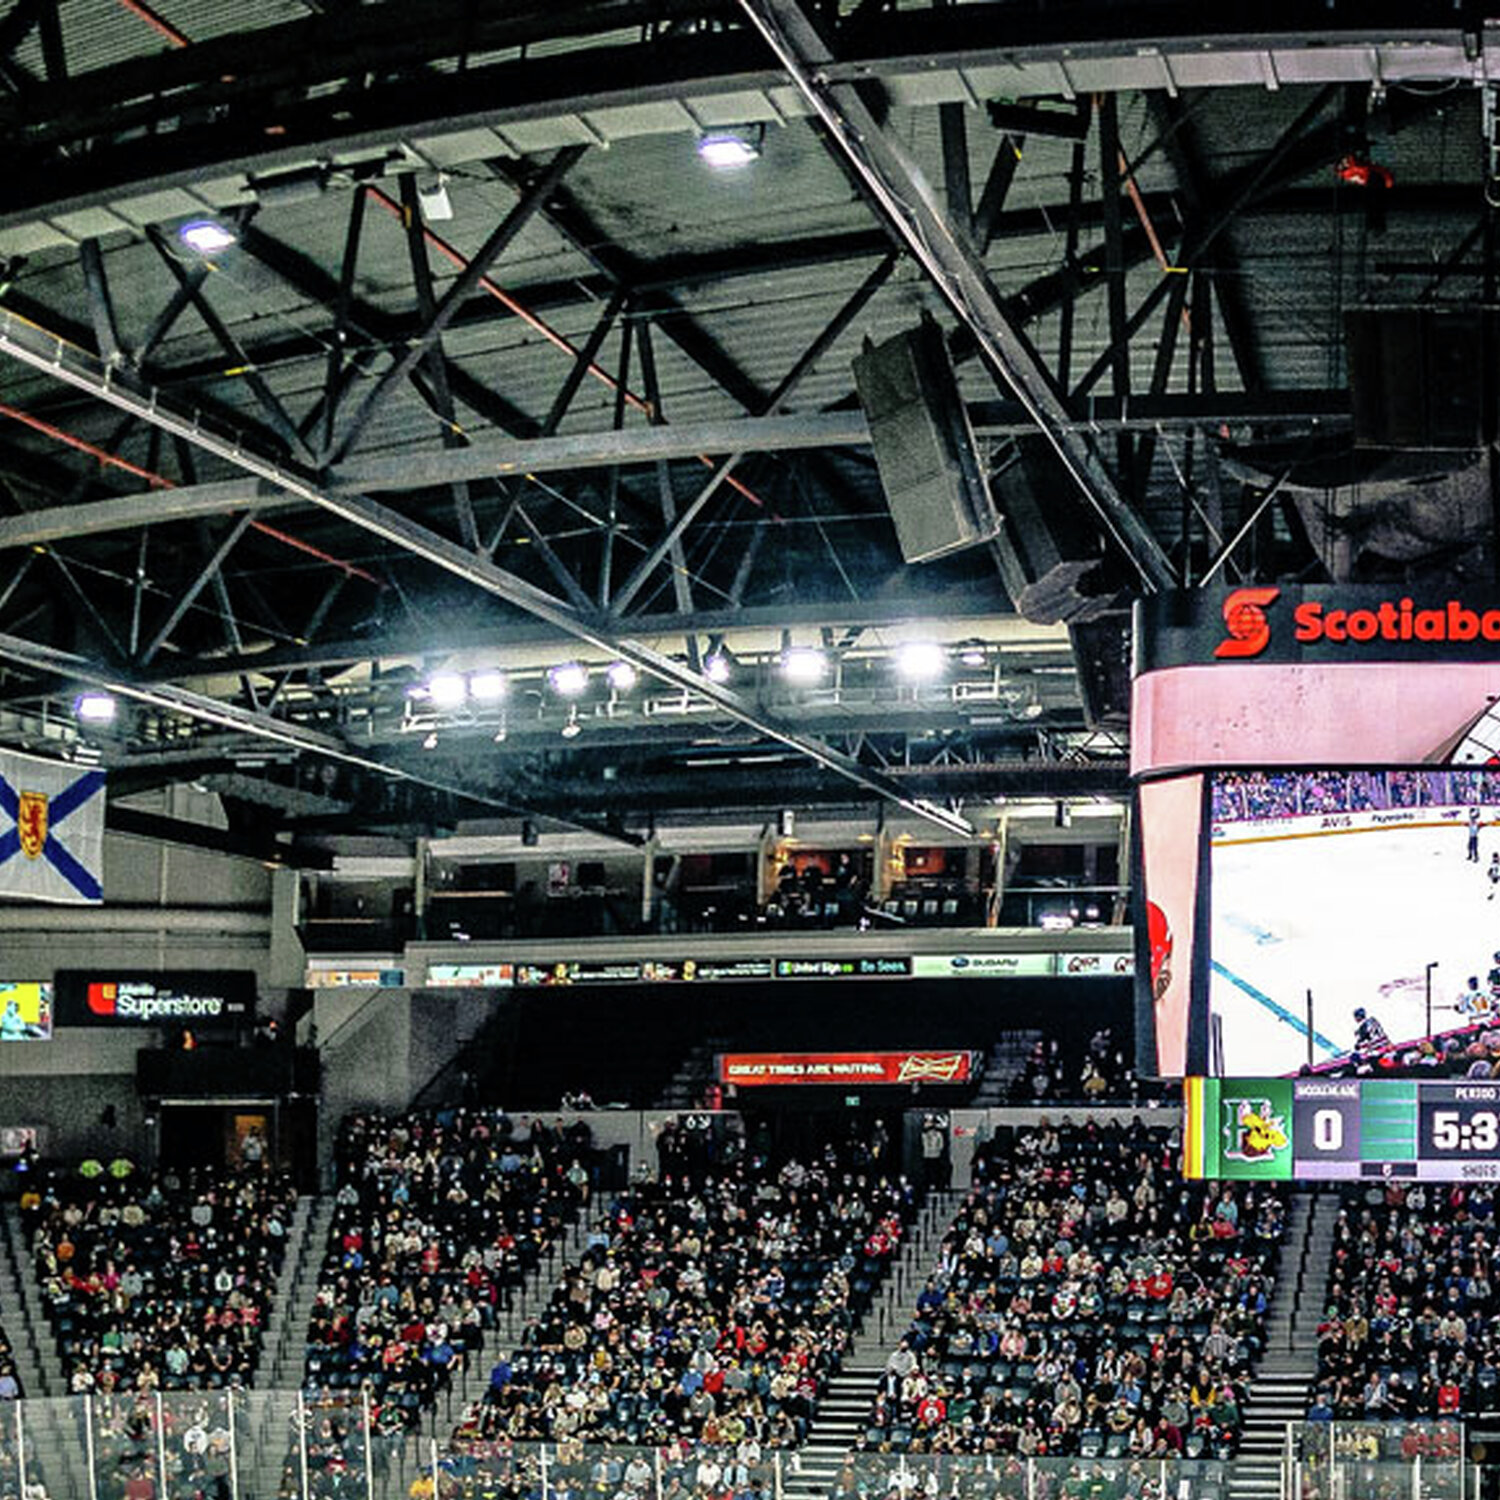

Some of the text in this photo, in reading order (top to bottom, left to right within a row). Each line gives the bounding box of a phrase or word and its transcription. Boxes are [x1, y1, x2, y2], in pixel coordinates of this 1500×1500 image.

[116, 994, 223, 1021] Superstore
[806, 1063, 832, 1075] ARE
[1313, 1109, 1343, 1151] 0
